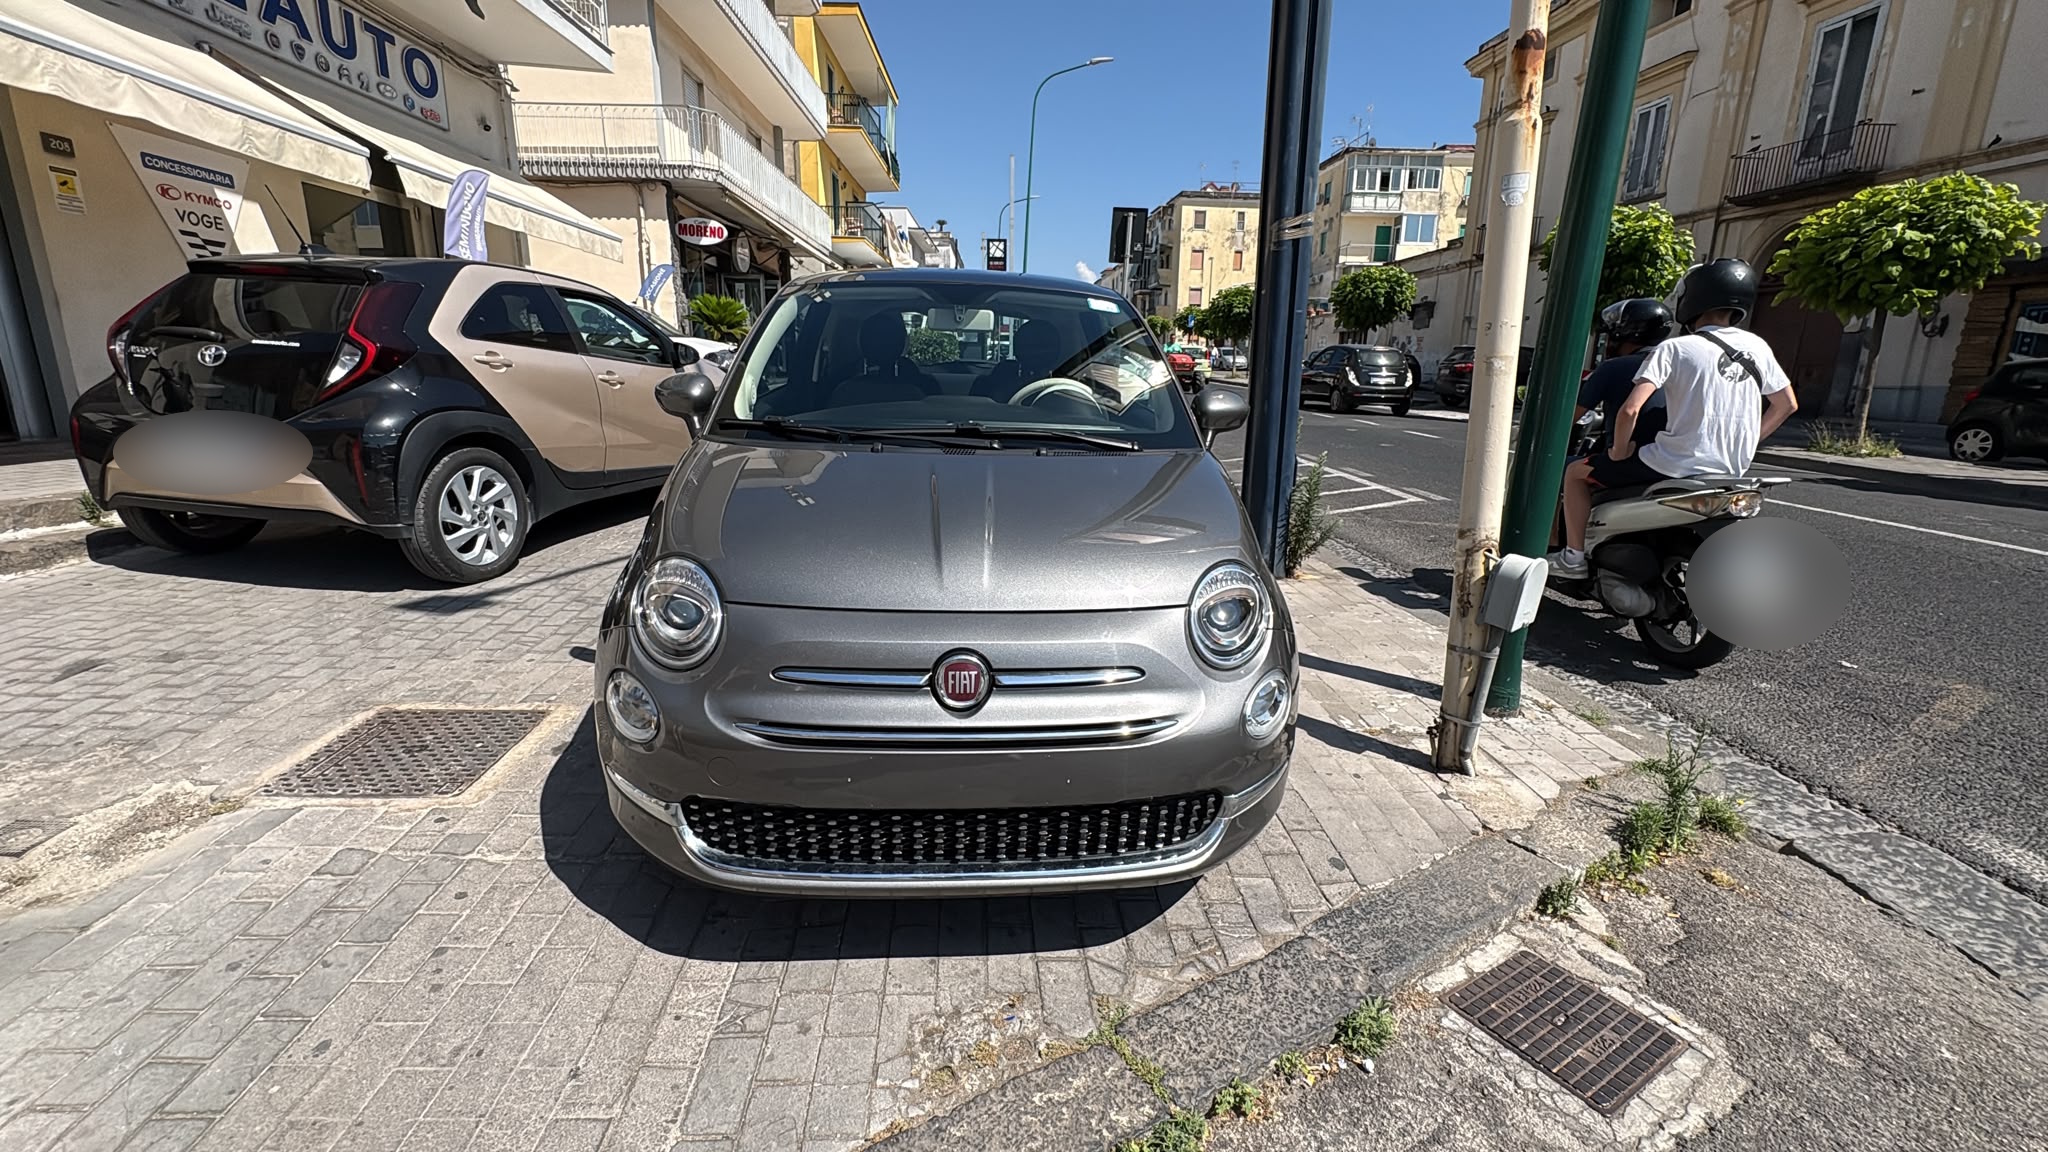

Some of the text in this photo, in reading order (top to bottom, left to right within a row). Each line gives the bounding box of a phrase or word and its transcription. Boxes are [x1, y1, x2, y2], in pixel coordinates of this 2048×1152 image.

[218, 0, 439, 99] AUTO
[144, 156, 232, 186] CONCESSIONARIA
[184, 191, 232, 210] KYMCO
[174, 208, 225, 231] VOGE
[678, 223, 724, 240] MORENO
[644, 267, 666, 300] OCCASIONE
[948, 671, 978, 694] FIAT
